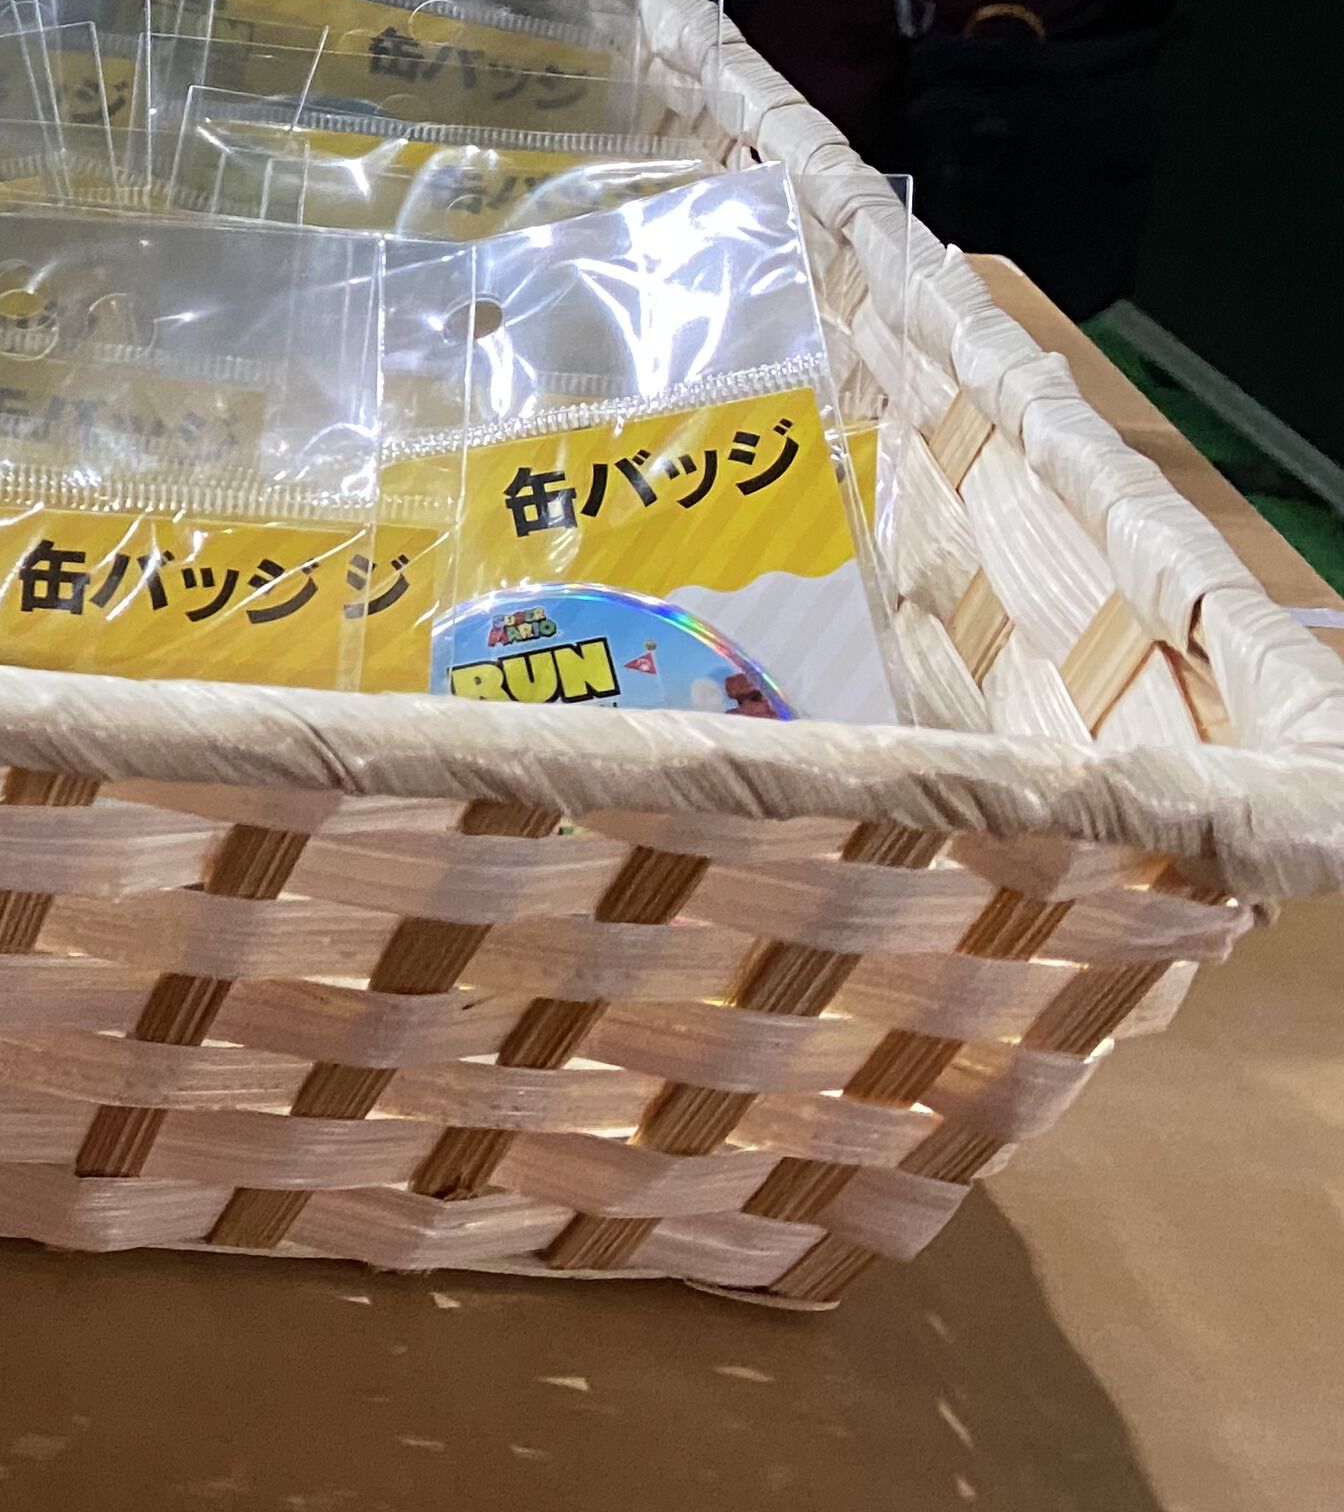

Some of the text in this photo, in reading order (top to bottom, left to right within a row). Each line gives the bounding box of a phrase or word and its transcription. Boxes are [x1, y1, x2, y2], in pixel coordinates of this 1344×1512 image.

[503, 418, 799, 537] 缶バッジ
[19, 539, 320, 625] 缶バッジ
[447, 636, 620, 703] RUN
[487, 619, 558, 648] MARIO
